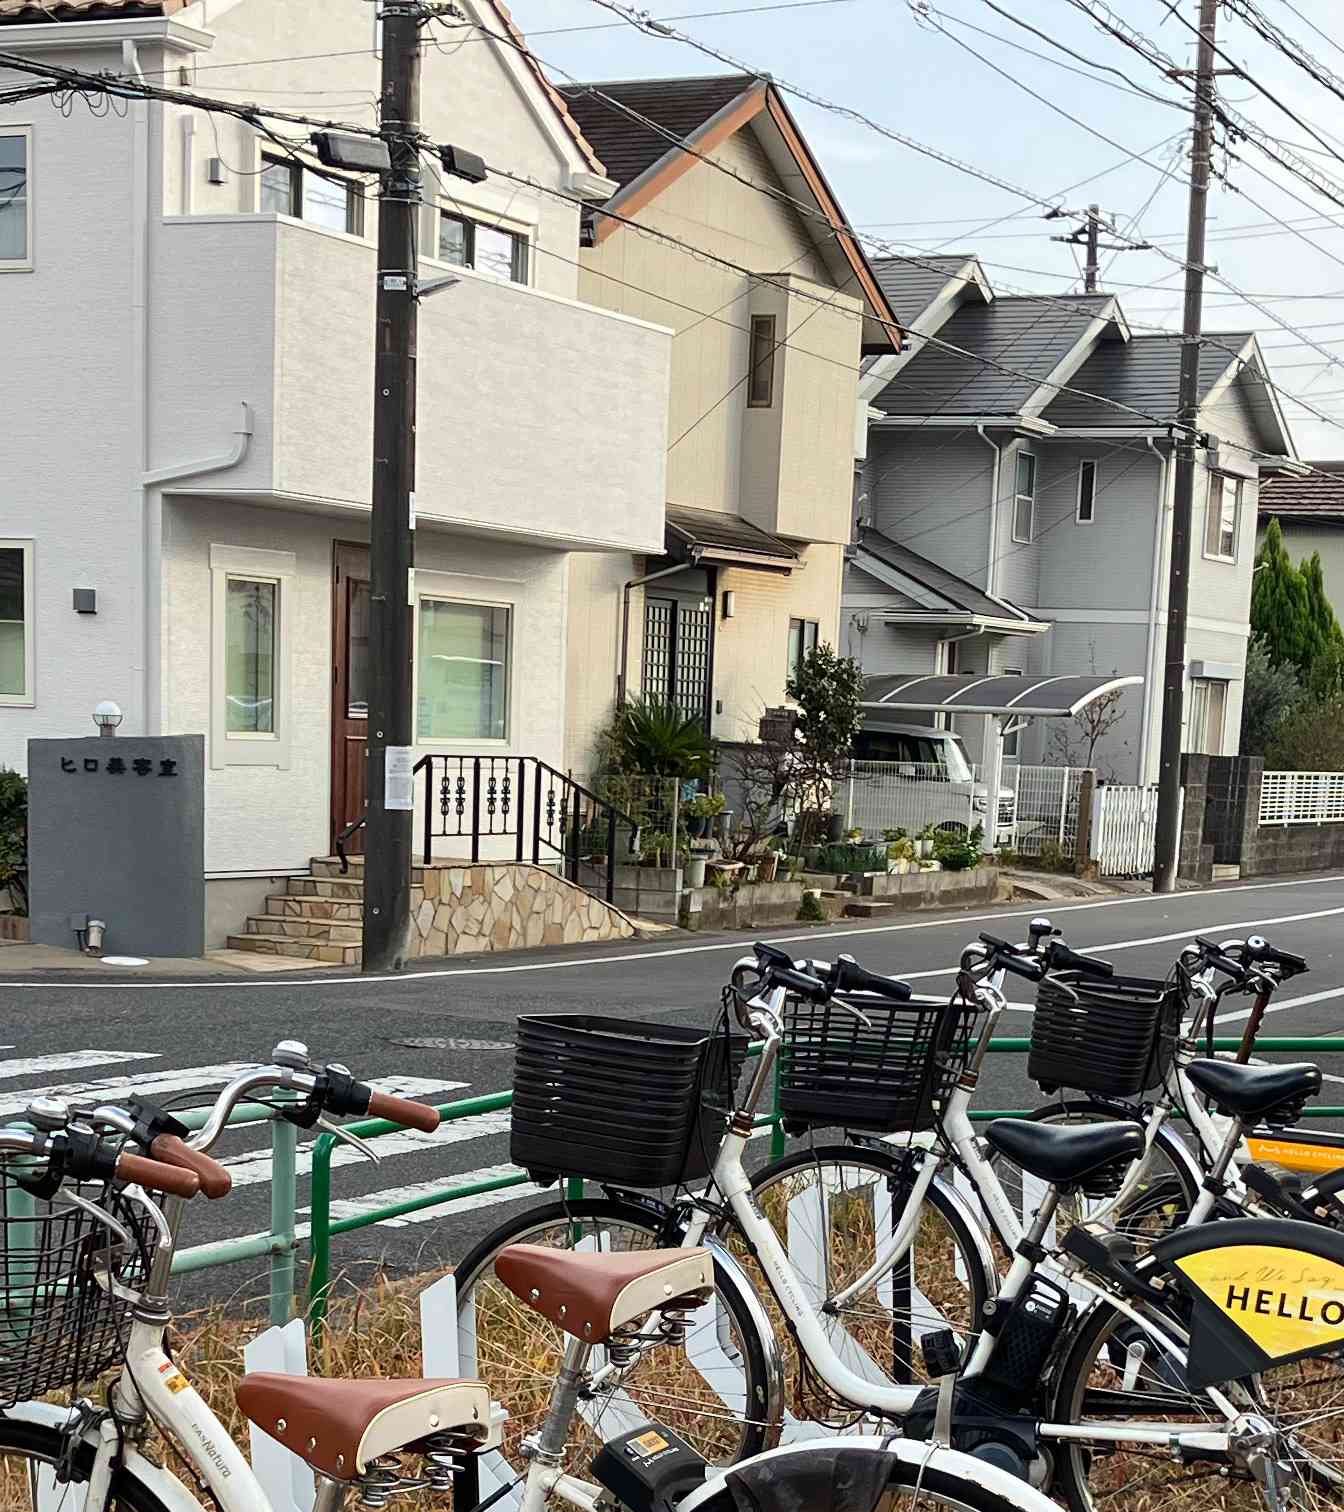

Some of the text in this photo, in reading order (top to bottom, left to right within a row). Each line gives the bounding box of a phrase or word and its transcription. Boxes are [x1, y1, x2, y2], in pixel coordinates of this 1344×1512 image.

[61, 757, 178, 777] ヒロ美容室
